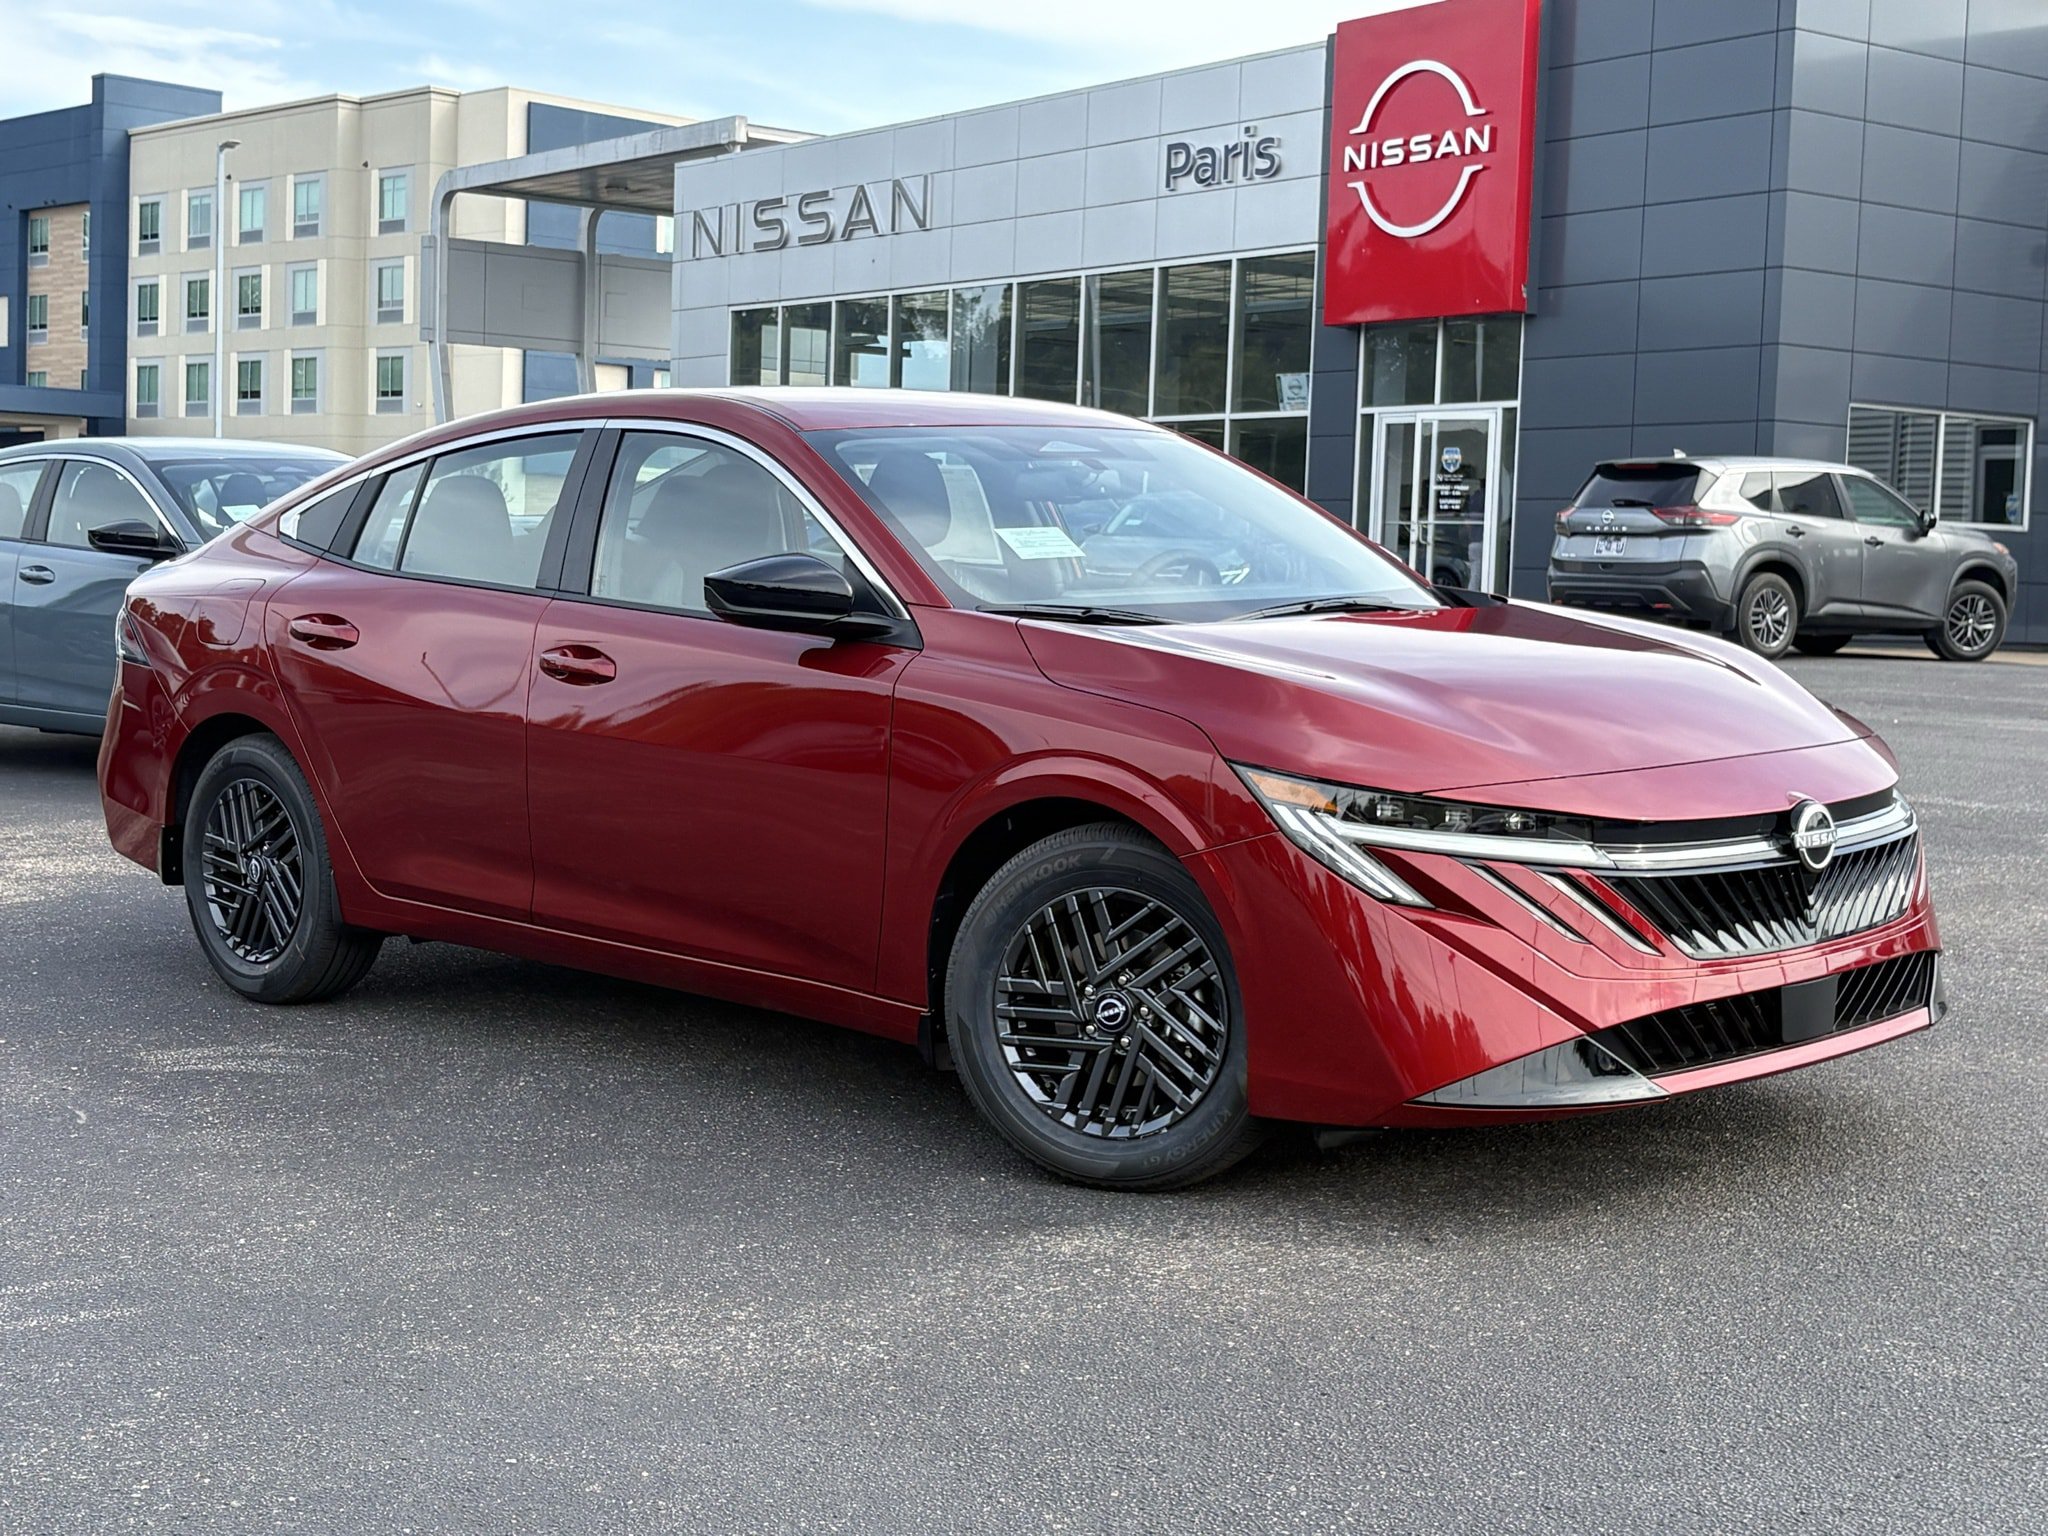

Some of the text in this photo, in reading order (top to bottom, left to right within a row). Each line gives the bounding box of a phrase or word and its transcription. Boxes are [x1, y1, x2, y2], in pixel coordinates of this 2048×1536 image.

[1165, 126, 1280, 189] Paris
[1343, 124, 1491, 172] NISSAN
[692, 174, 931, 258] NISSAN
